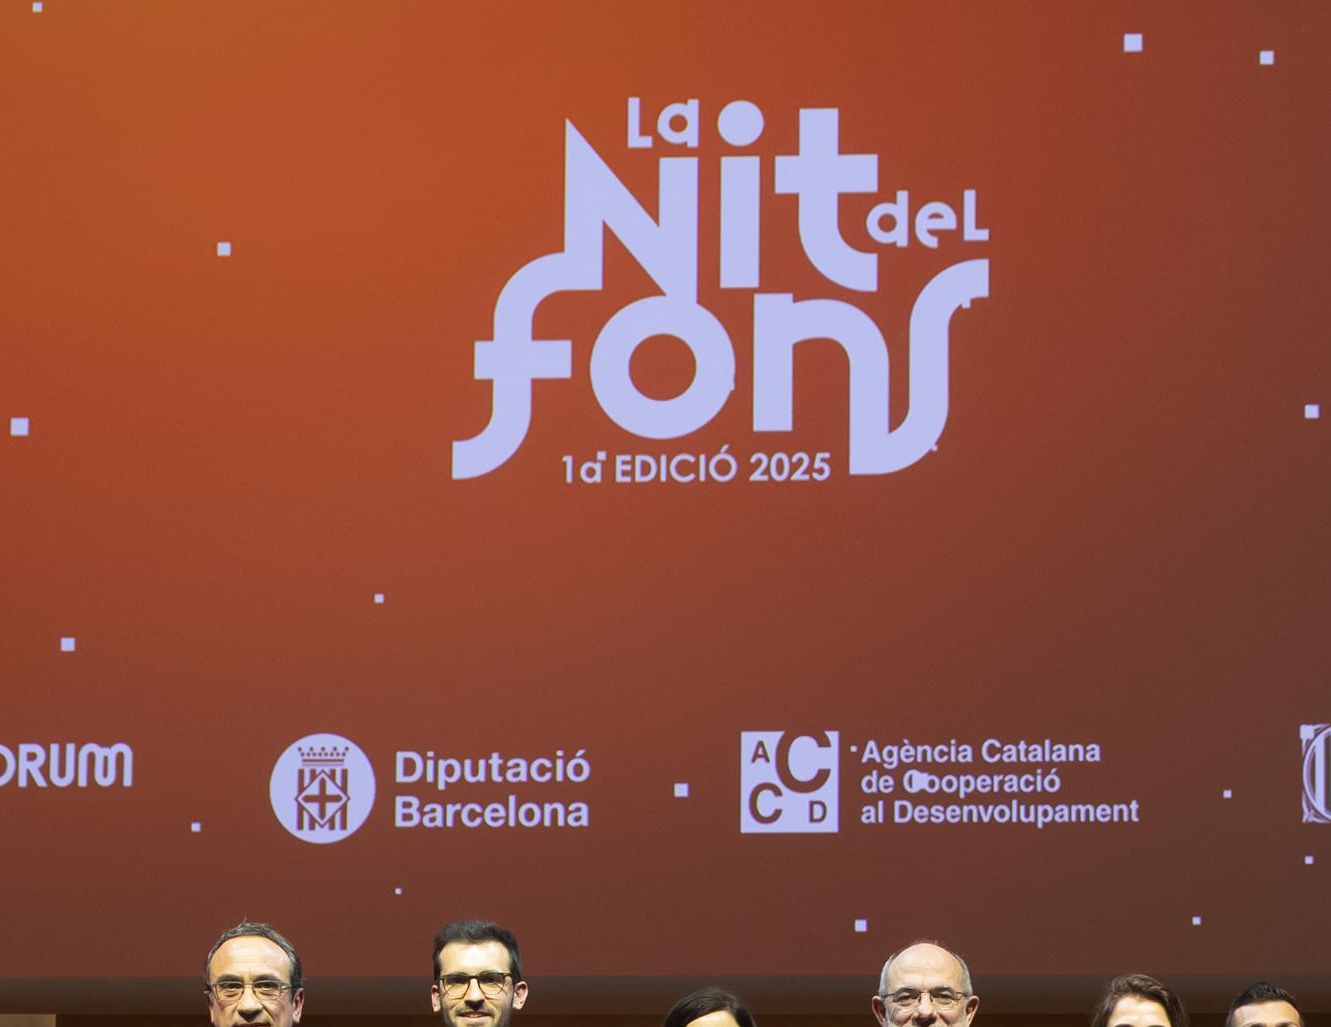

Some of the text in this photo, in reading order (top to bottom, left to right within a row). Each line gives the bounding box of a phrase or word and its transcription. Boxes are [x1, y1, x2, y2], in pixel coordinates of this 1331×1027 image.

[627, 97, 700, 149] La
[564, 100, 879, 293] Nit
[615, 444, 738, 483] EDICIÓ
[749, 452, 831, 481] 2025
[395, 749, 591, 790] Diputació
[861, 739, 1101, 769] Agència Catalana
[861, 768, 1061, 799] de Cooperació
[394, 795, 590, 827] Barcelona
[861, 800, 1140, 828] al Desenvolupament
